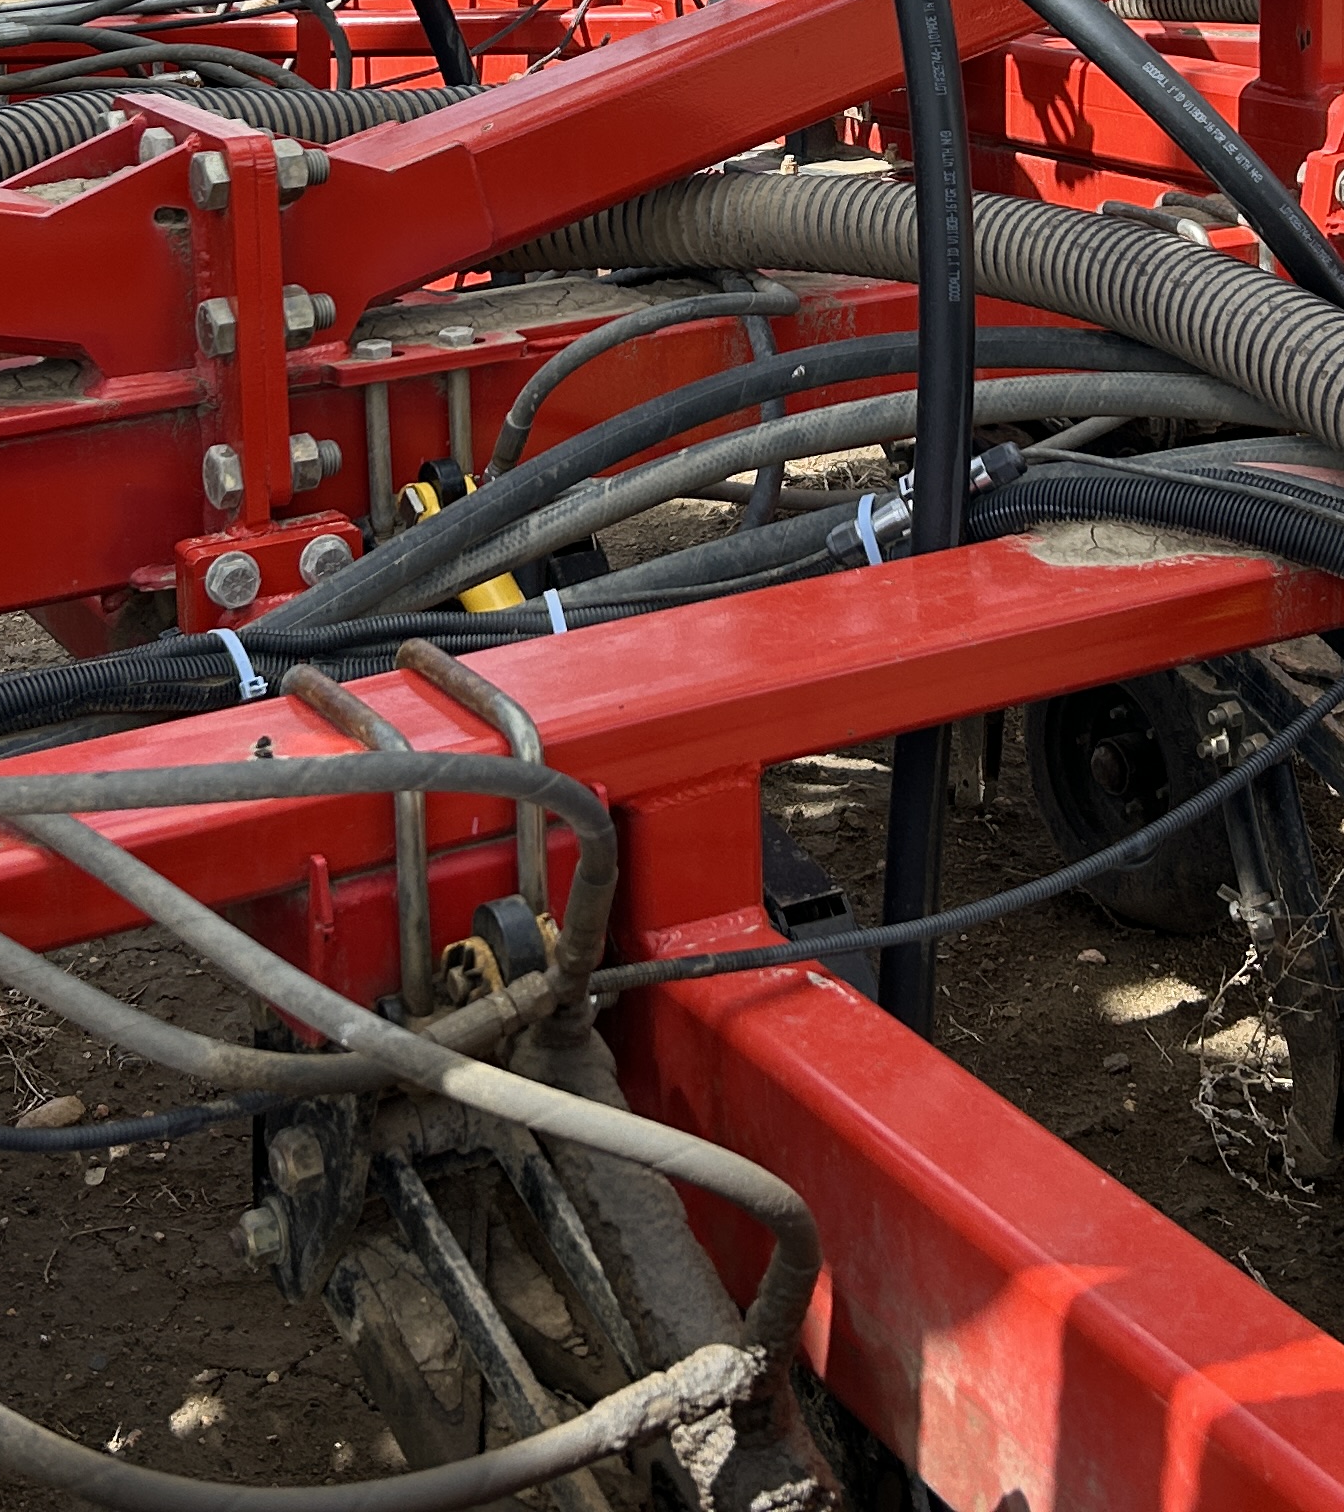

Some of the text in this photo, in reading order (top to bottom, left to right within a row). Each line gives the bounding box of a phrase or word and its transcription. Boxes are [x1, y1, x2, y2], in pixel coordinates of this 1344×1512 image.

[1142, 61, 1170, 88] GOODALL
[1211, 128, 1227, 144] FOR
[1223, 140, 1239, 156] USE
[1235, 152, 1253, 171] WITH
[941, 148, 955, 167] WITH
[944, 170, 957, 186] USE
[944, 188, 957, 203] FOR
[948, 270, 961, 302] GOODALL
